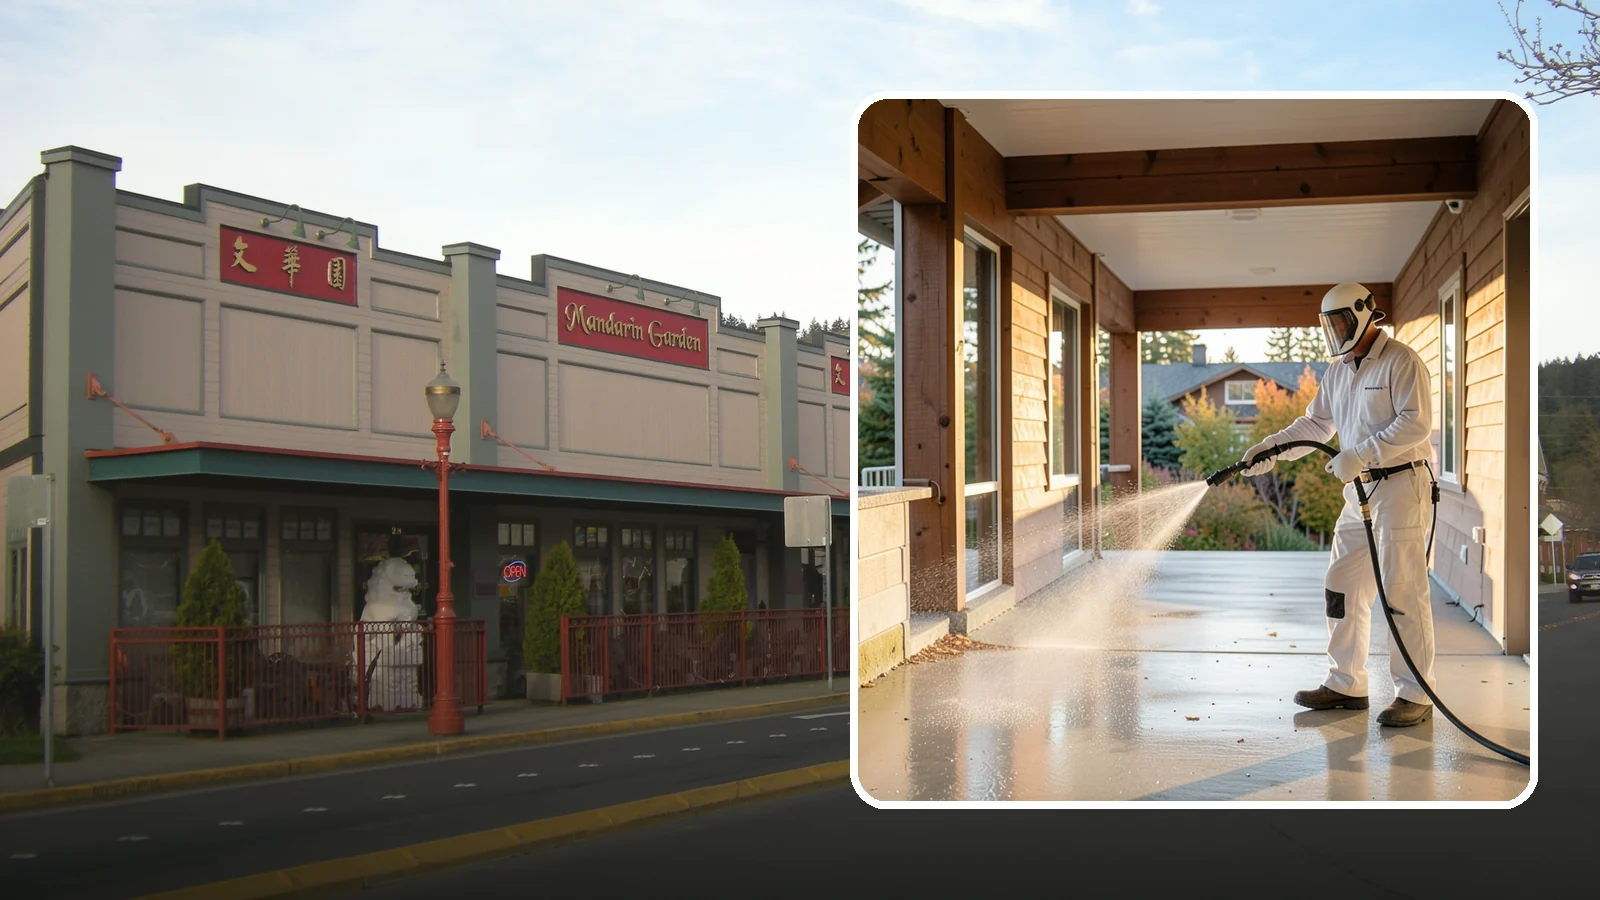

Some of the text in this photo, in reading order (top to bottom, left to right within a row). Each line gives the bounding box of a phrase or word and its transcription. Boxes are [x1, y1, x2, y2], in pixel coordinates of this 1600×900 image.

[231, 236, 346, 291] 文華園
[564, 302, 701, 352] Mandarin Garden
[503, 565, 527, 578] OPEN
